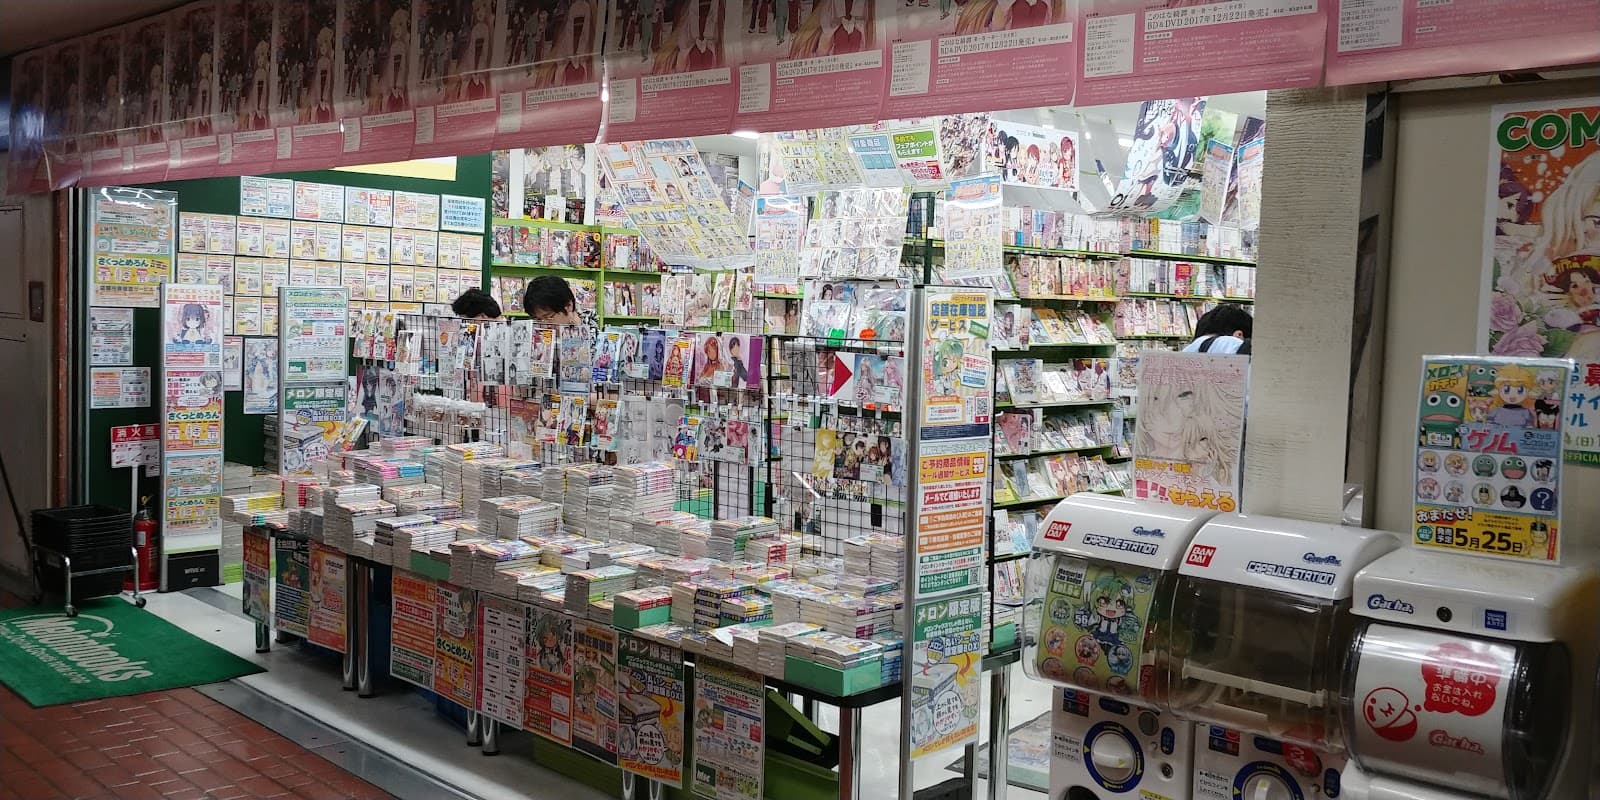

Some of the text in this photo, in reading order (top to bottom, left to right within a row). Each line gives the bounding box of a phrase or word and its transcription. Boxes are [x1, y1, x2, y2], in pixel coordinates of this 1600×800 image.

[98, 257, 149, 268] さくっとめろん
[930, 319, 967, 332] サービス
[168, 411, 219, 421] さくっとめろん
[117, 427, 155, 438] 消火器
[1467, 429, 1518, 455] ゲノム
[1168, 484, 1236, 513] もらえる
[1416, 506, 1473, 523] おまたせ!
[1050, 521, 1069, 532] BAN
[1046, 529, 1063, 538] DAI
[1455, 527, 1523, 553] 5月25日
[1082, 533, 1158, 556] CAPSULE STATION
[1192, 546, 1214, 557] BAN
[1188, 553, 1207, 564] DAI
[1246, 560, 1336, 586] CAPSULE STATION
[1075, 614, 1088, 624] 56
[1432, 683, 1483, 700] お金は入れ
[1431, 692, 1475, 710] ないでね。
